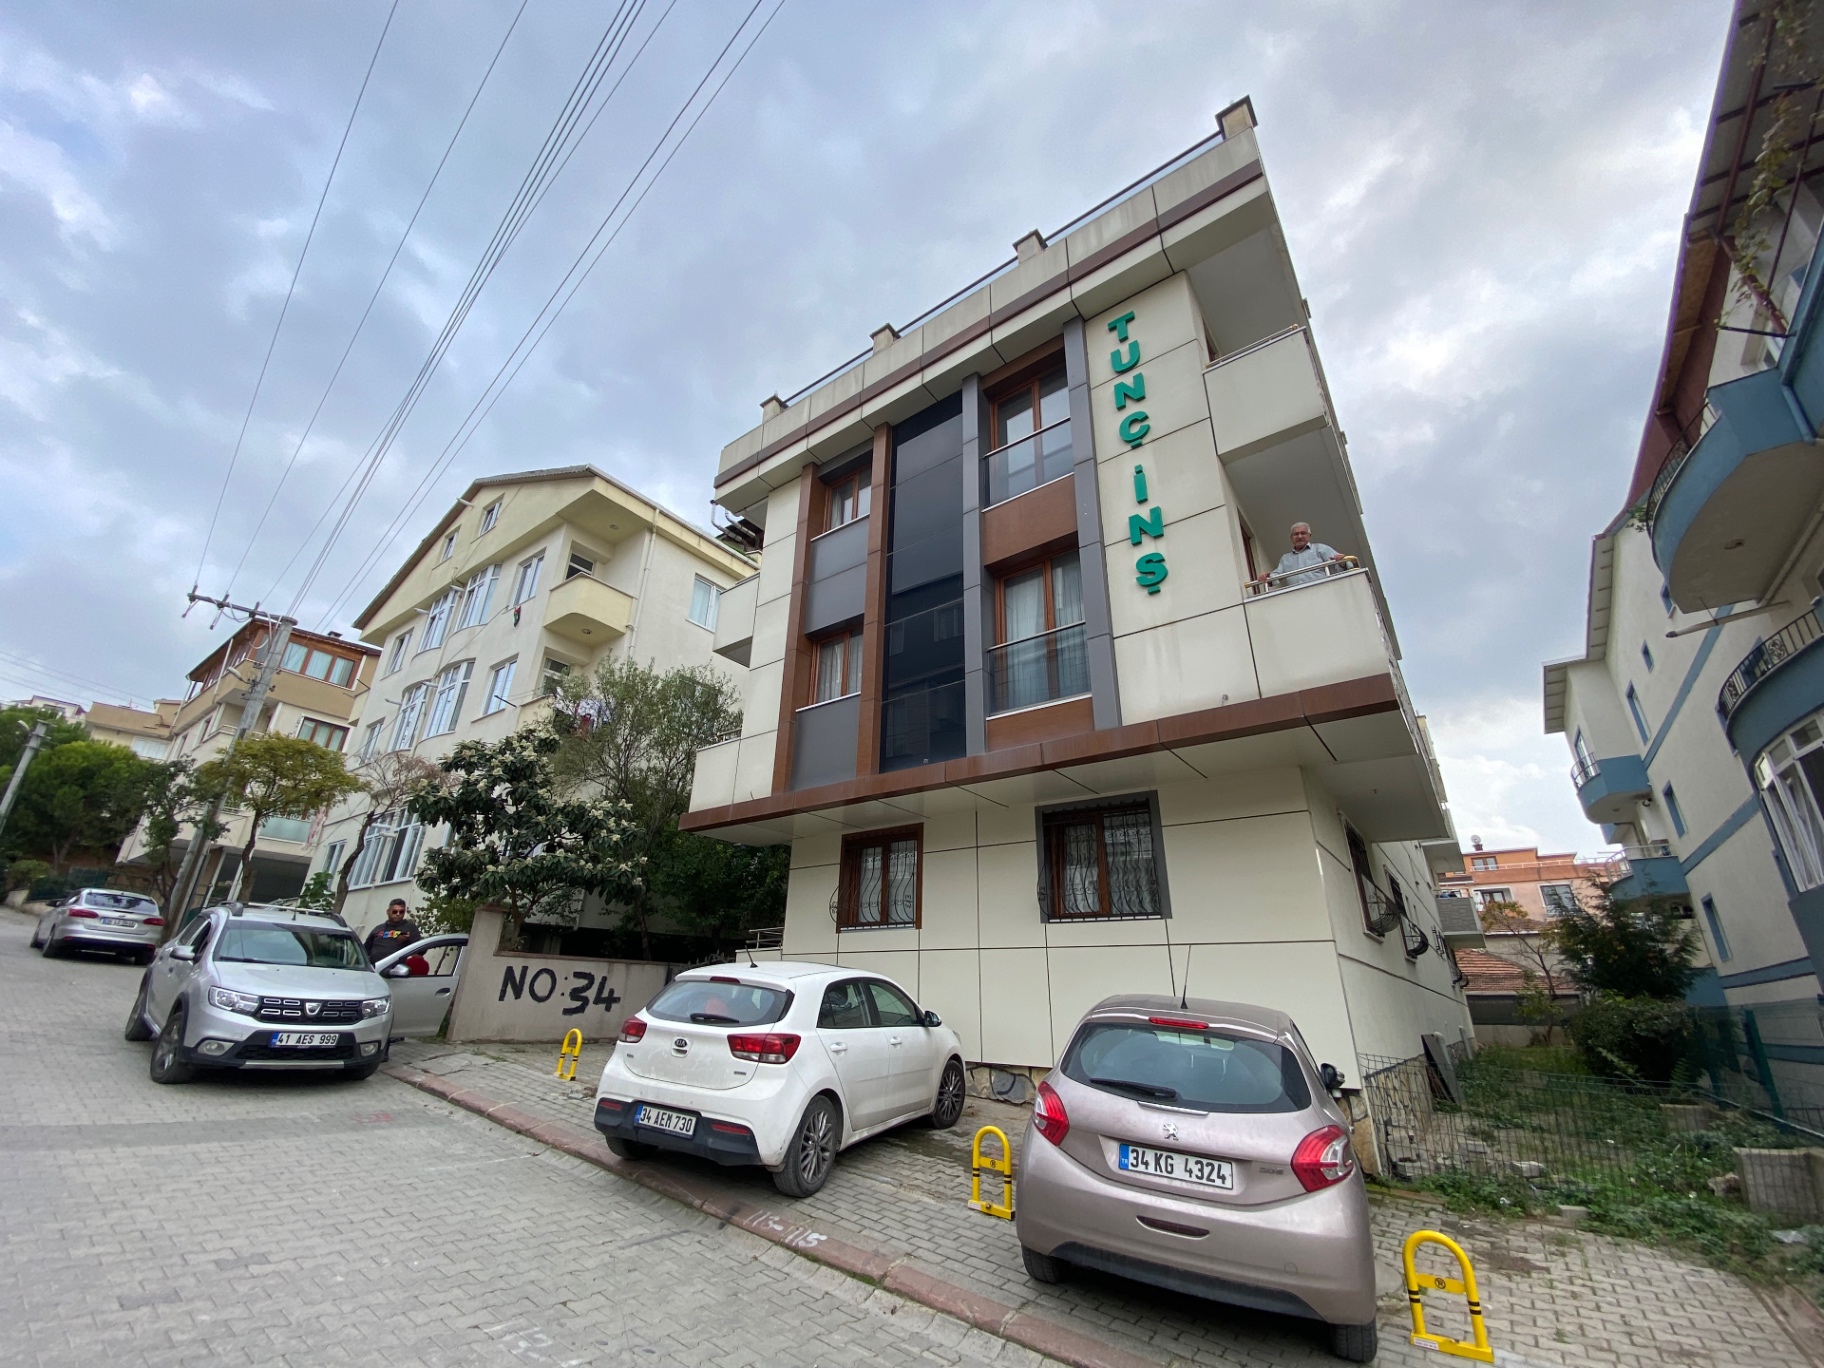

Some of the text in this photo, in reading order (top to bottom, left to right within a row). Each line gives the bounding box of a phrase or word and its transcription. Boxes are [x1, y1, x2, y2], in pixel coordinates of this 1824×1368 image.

[278, 1034, 337, 1045] 41 AES 999
[640, 1107, 652, 1123] 34
[673, 1115, 693, 1133] 730
[1130, 1148, 1150, 1170] 34
[1154, 1152, 1174, 1175] KG
[1184, 1158, 1227, 1185] 4324
